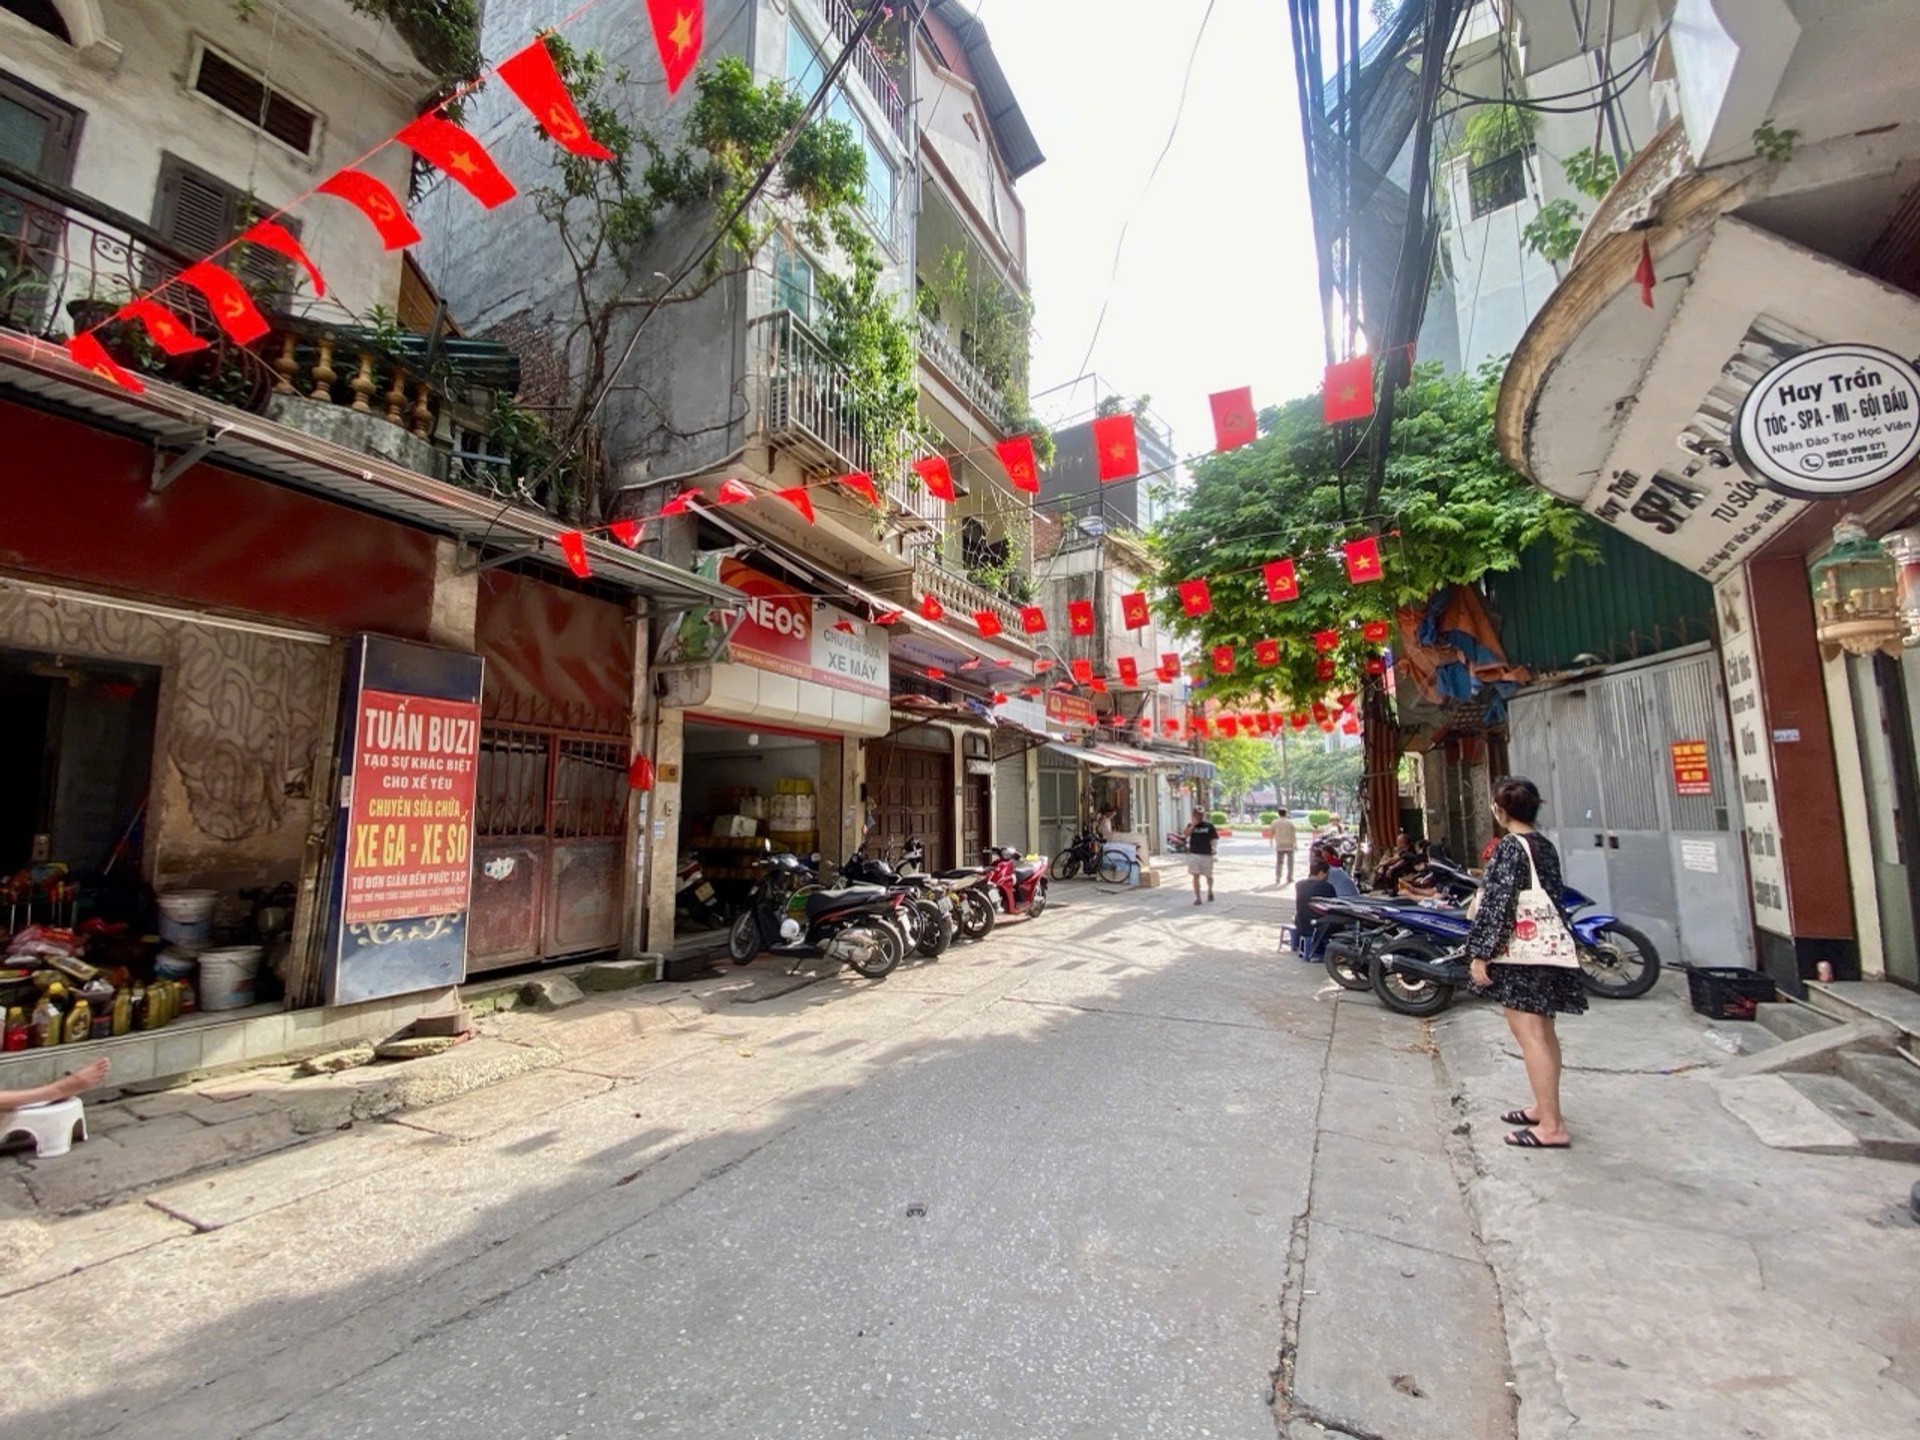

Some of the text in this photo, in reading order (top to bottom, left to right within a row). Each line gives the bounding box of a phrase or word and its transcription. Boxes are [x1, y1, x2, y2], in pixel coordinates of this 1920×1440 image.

[1778, 382, 1823, 407] Huy
[1828, 366, 1883, 394] Trần
[1764, 411, 1788, 437] TÓC
[1797, 407, 1824, 430] SPA
[1832, 402, 1850, 424] MI
[1859, 393, 1881, 421] GỘI
[1772, 439, 1803, 454] Nhận
[1832, 431, 1855, 443] Tạo
[1857, 425, 1882, 439] Học
[1884, 419, 1912, 433] Viên
[1630, 470, 1708, 535] SPA
[1711, 501, 1738, 523] TU
[828, 651, 846, 672] XE
[850, 659, 877, 680] MÁY
[365, 698, 475, 755] TUẤN BUZI
[363, 753, 472, 774] TẠO SỰ KHÁC BIỆT
[382, 775, 409, 789] CHO
[430, 776, 452, 790] YÊU
[369, 793, 460, 817] CHUYÊN SỬA CHỮA
[354, 824, 379, 868] XE
[383, 824, 405, 867] GA
[420, 824, 443, 865] XE
[446, 810, 469, 863] SỐ
